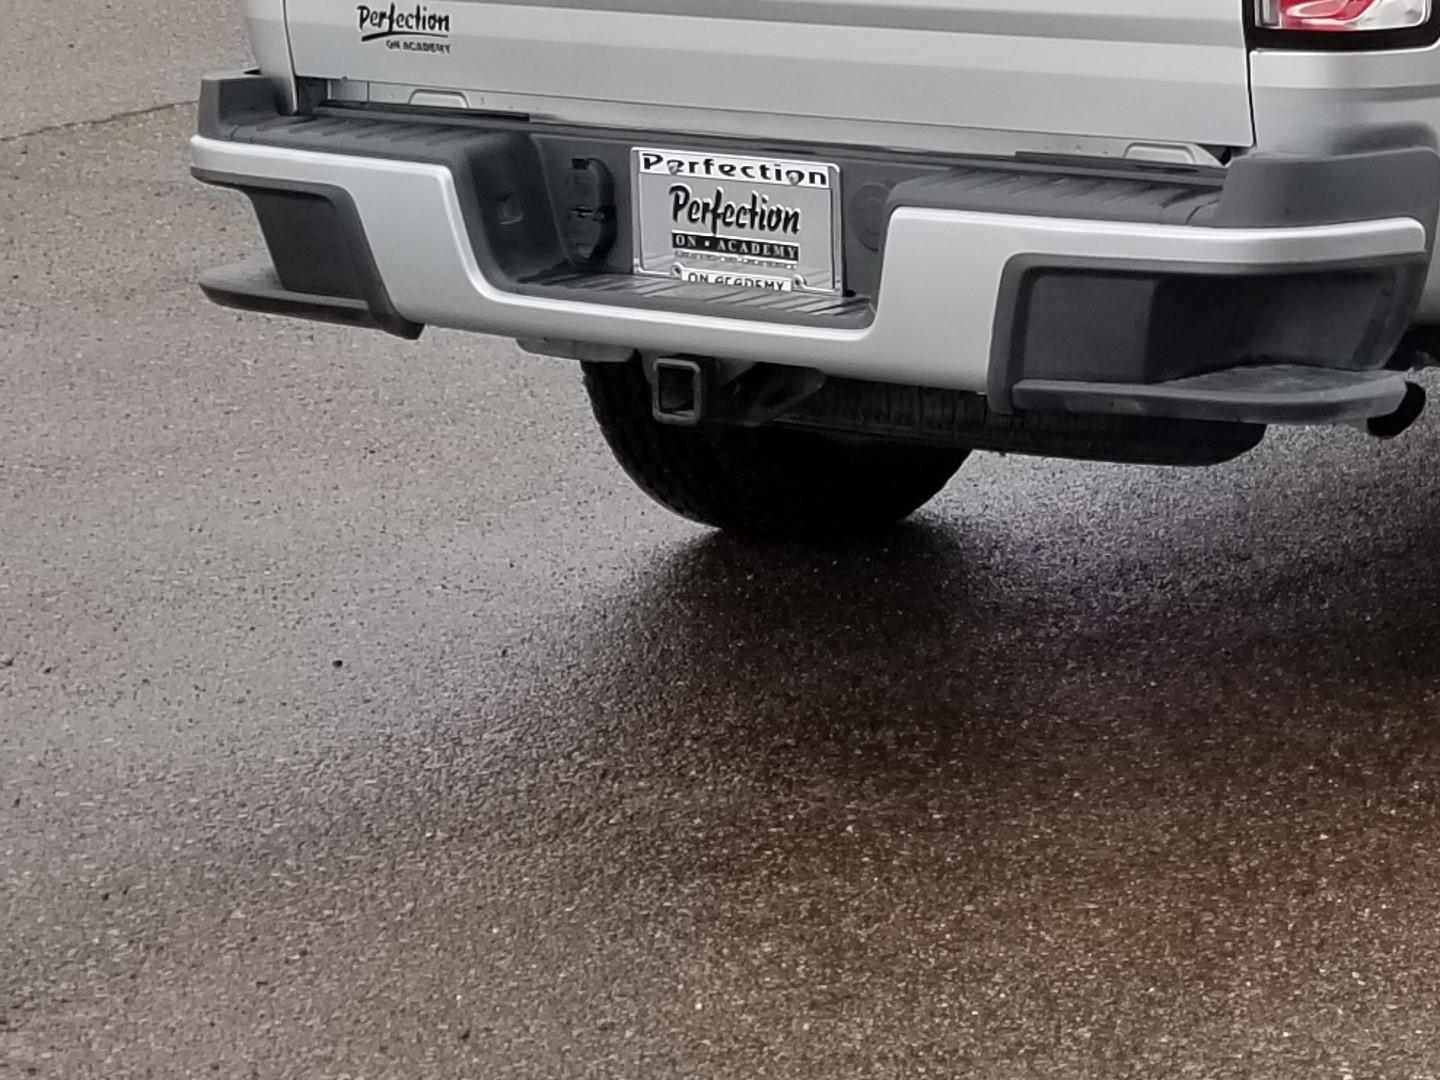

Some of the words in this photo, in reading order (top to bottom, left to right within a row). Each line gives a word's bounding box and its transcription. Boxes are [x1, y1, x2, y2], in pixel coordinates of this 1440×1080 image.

[357, 2, 450, 32] Perfection
[386, 39, 401, 51] ON
[403, 41, 451, 54] ACADEMY
[642, 153, 828, 186] Perfection
[669, 184, 801, 236] Perfection
[675, 234, 698, 248] ON
[716, 237, 797, 260] ACADEMY
